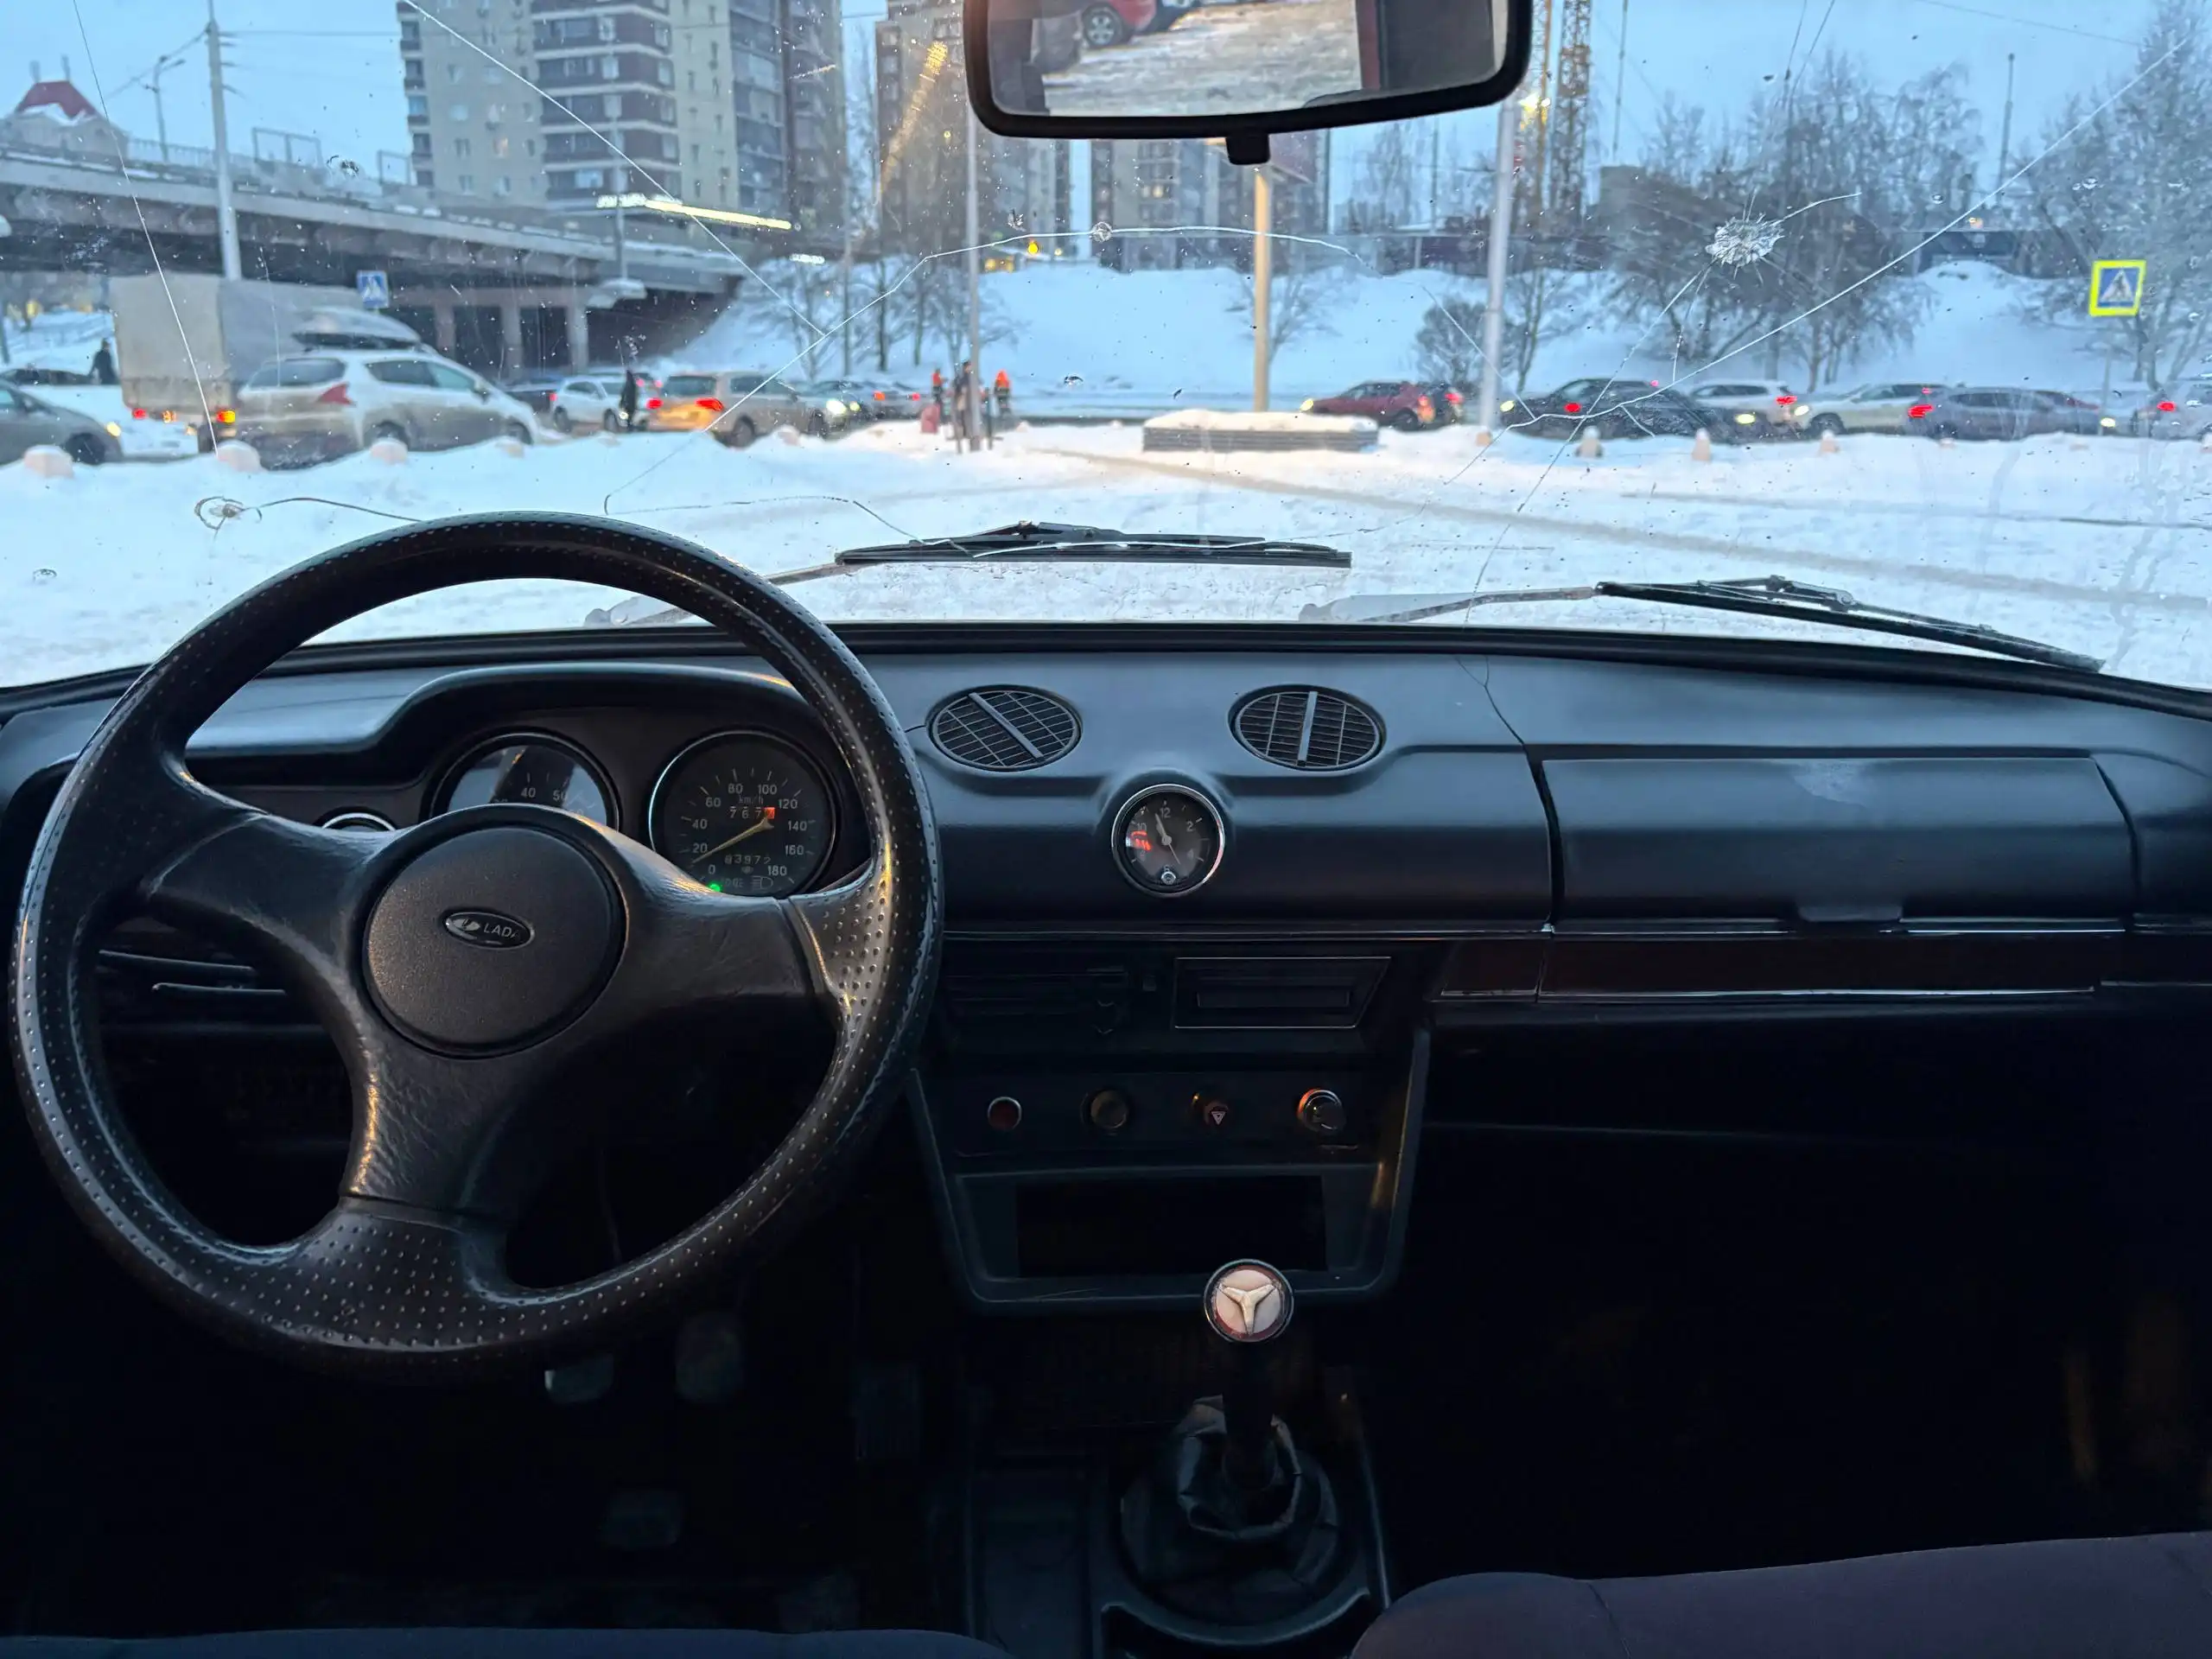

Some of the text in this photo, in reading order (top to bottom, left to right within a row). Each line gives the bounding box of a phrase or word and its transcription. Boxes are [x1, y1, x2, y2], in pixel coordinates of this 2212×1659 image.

[520, 787, 536, 798] 40
[728, 783, 743, 794] 80
[758, 784, 778, 795] 100
[705, 797, 721, 808] 60
[779, 798, 798, 809] 120
[1160, 807, 1171, 818] 12
[692, 818, 708, 830] 40
[787, 821, 808, 831] 140
[1186, 821, 1194, 832] 2
[692, 843, 709, 854] 20
[785, 844, 804, 855] 160
[708, 865, 716, 875] 0
[767, 865, 788, 876] 180
